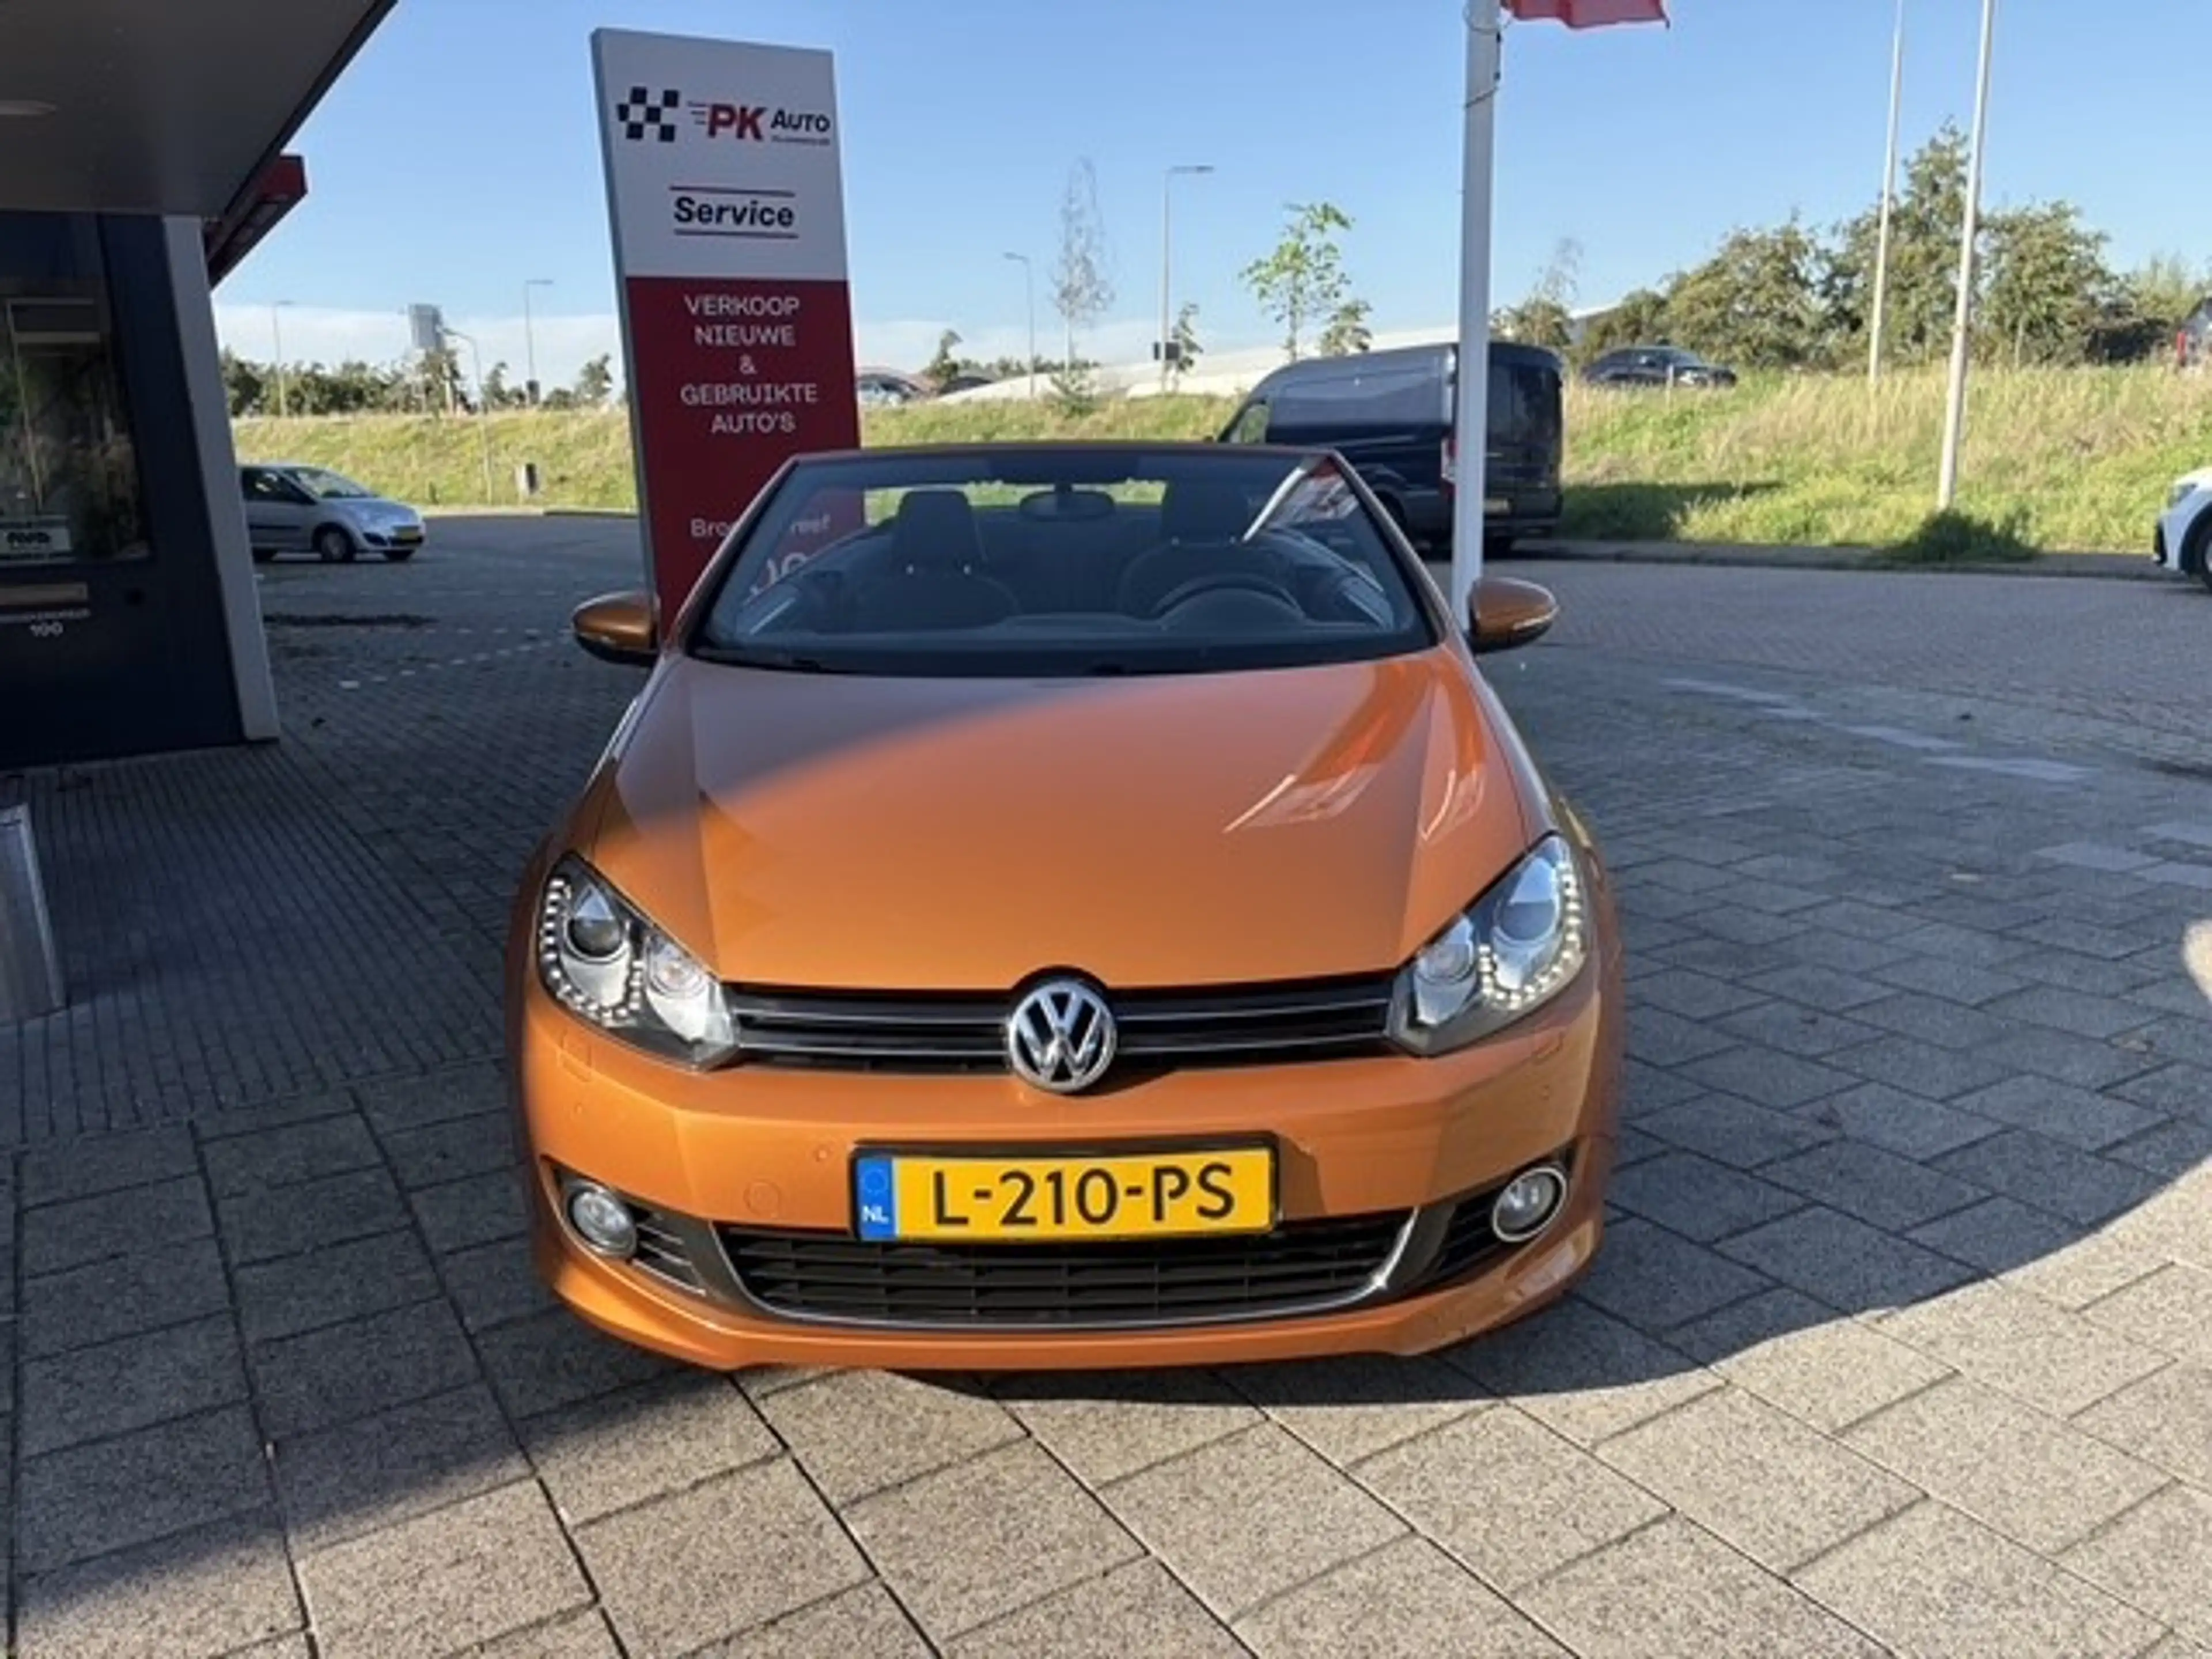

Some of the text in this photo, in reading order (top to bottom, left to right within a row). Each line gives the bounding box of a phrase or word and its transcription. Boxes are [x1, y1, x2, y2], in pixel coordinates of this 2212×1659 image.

[707, 104, 768, 141] PK
[674, 196, 795, 227] Service
[684, 294, 800, 316] VERKOOP
[695, 324, 797, 346] NIEUWE
[739, 353, 757, 375] &
[680, 382, 820, 406] GEBRUIKTE
[711, 411, 797, 434] AUTO'S
[933, 1164, 1236, 1226] L-210-PS
[863, 1205, 889, 1225] NL
